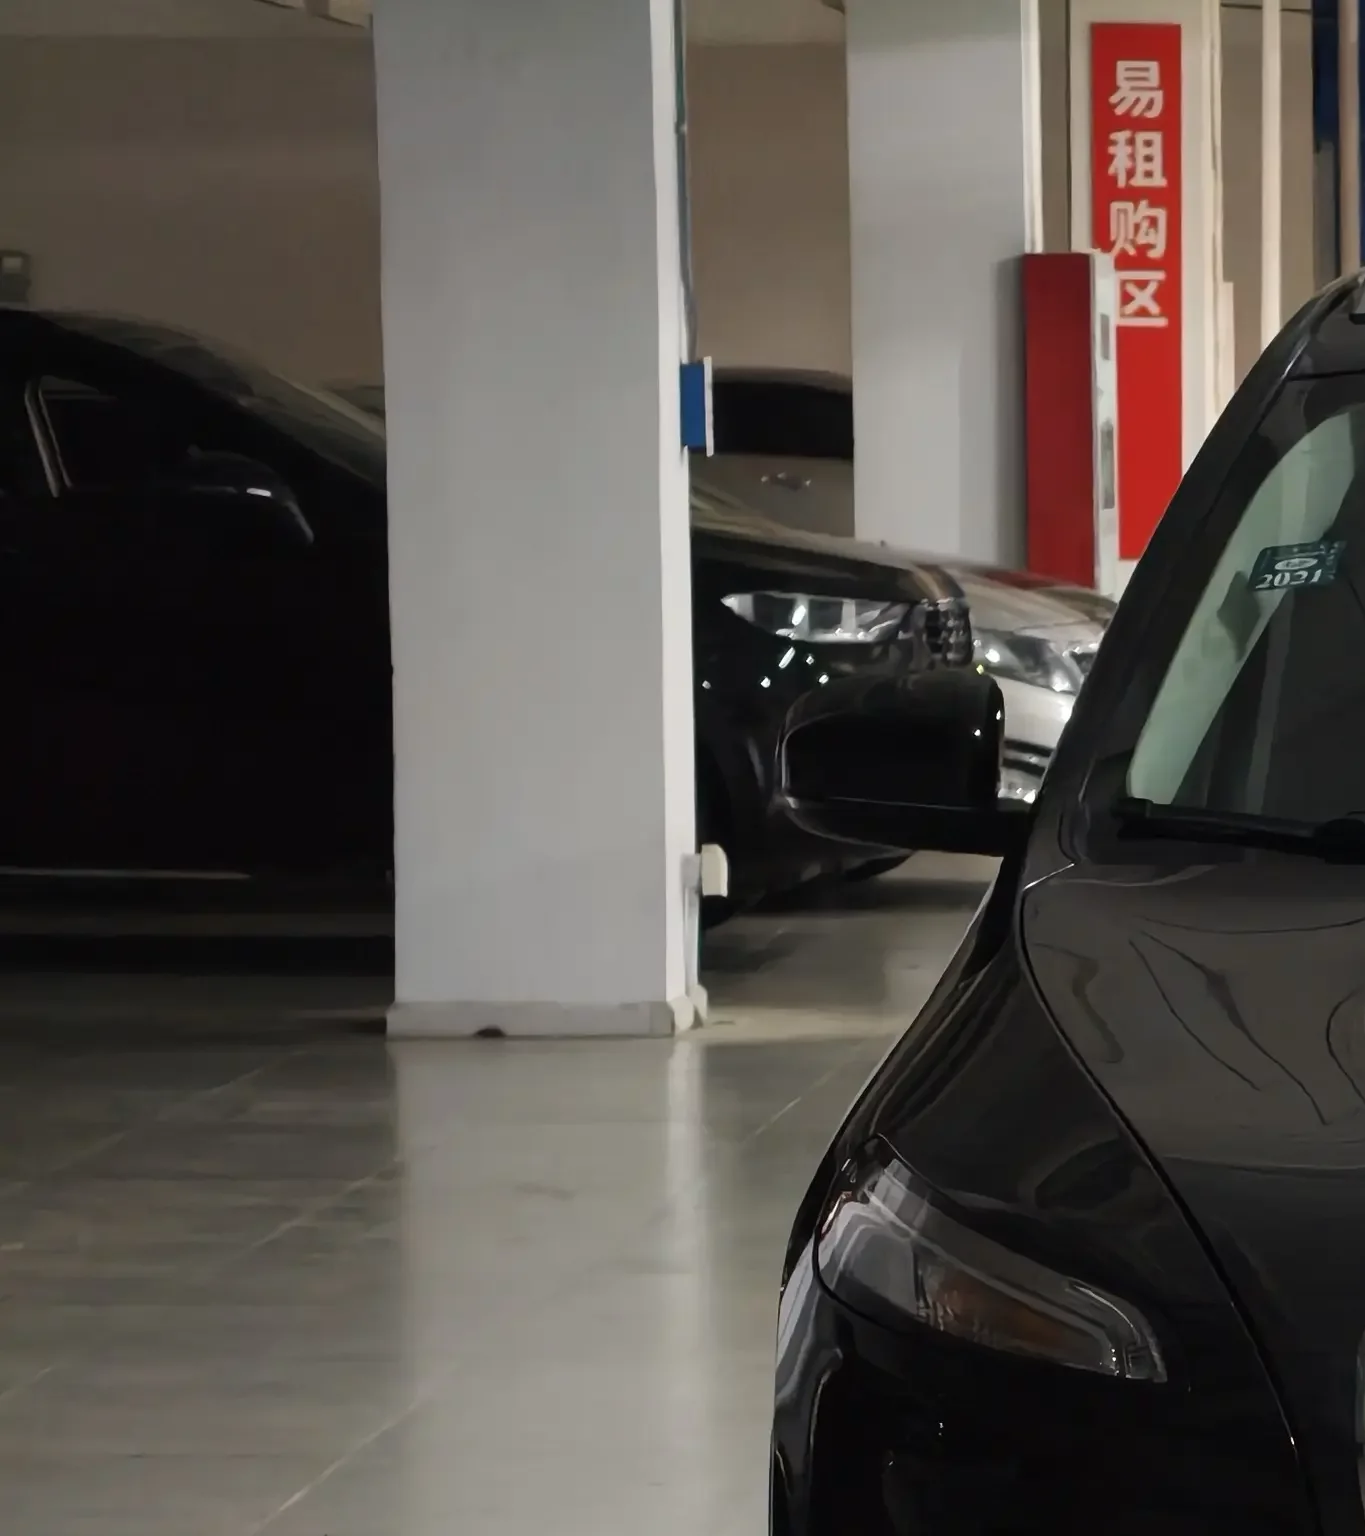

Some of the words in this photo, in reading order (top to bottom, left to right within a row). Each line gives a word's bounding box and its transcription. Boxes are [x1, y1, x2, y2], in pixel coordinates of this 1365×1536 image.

[1108, 60, 1168, 328] 易租购区
[1256, 569, 1323, 589] 2021
